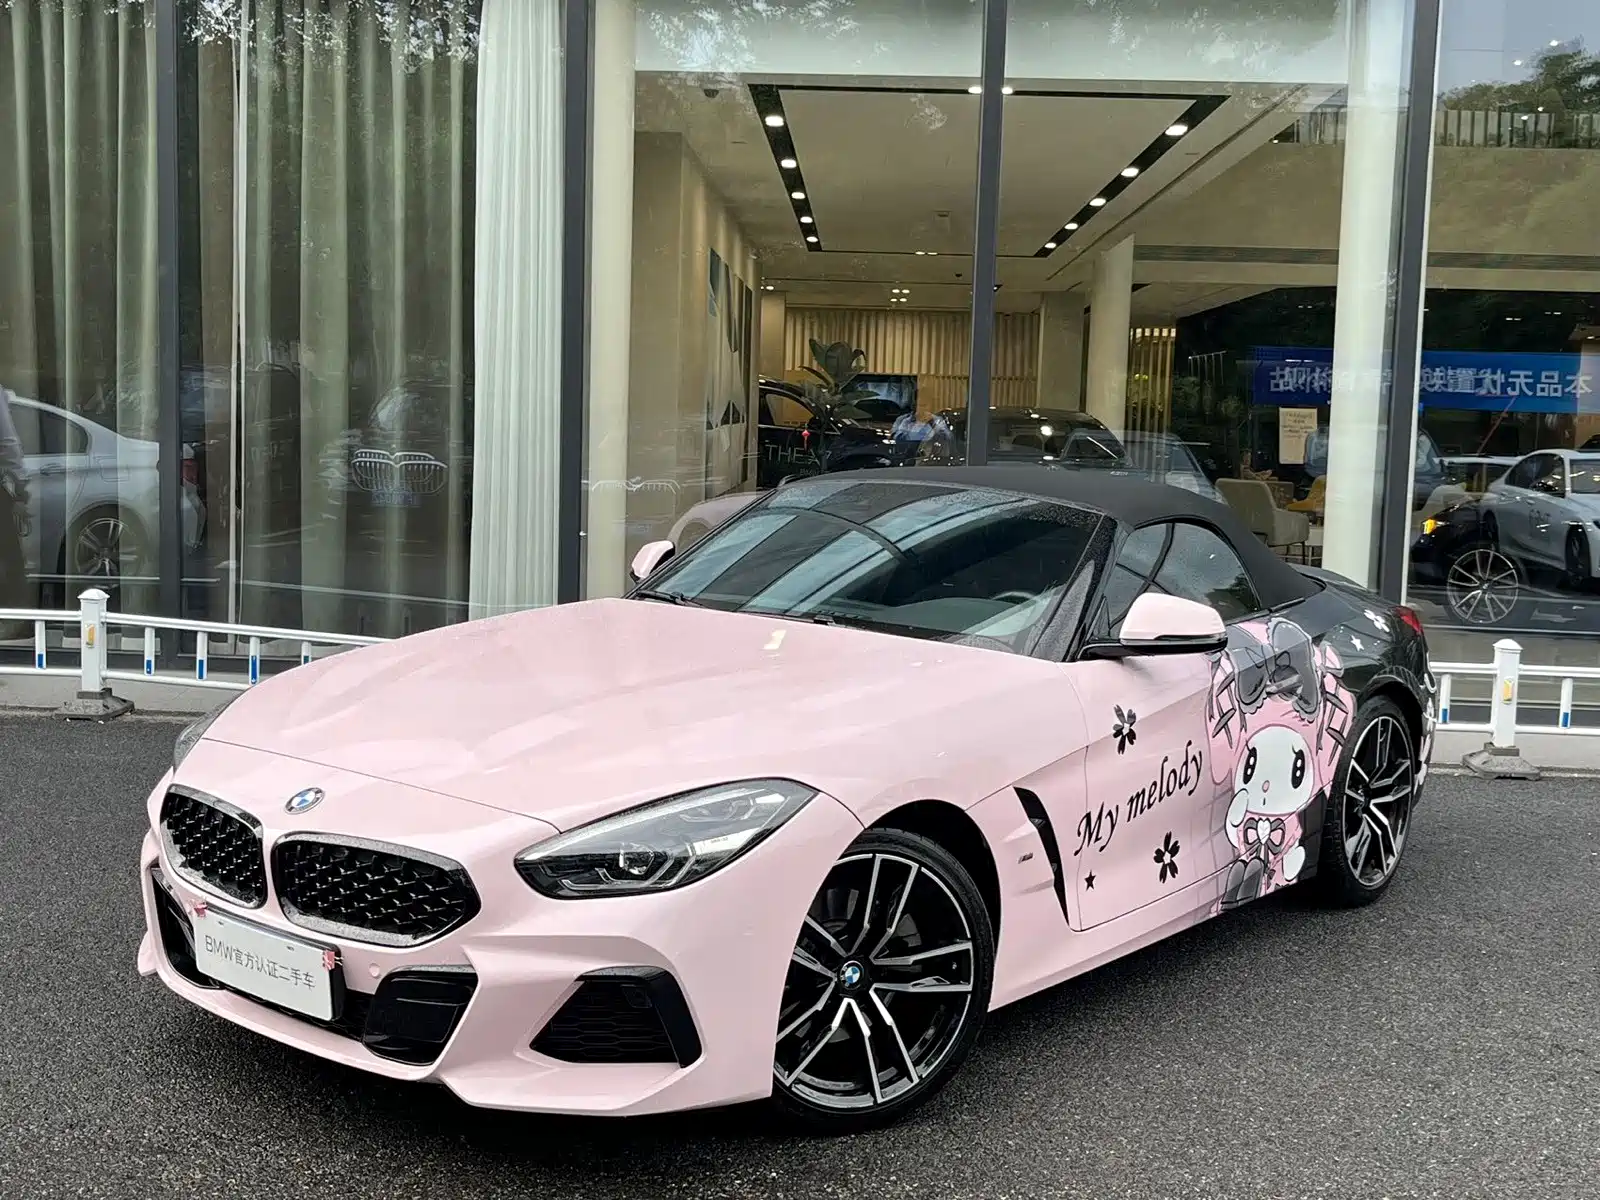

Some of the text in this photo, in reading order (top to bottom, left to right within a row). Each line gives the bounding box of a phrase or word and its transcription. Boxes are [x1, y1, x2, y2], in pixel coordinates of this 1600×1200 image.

[1073, 740, 1203, 856] My melody
[205, 935, 316, 992] BMW官方认证二手车
